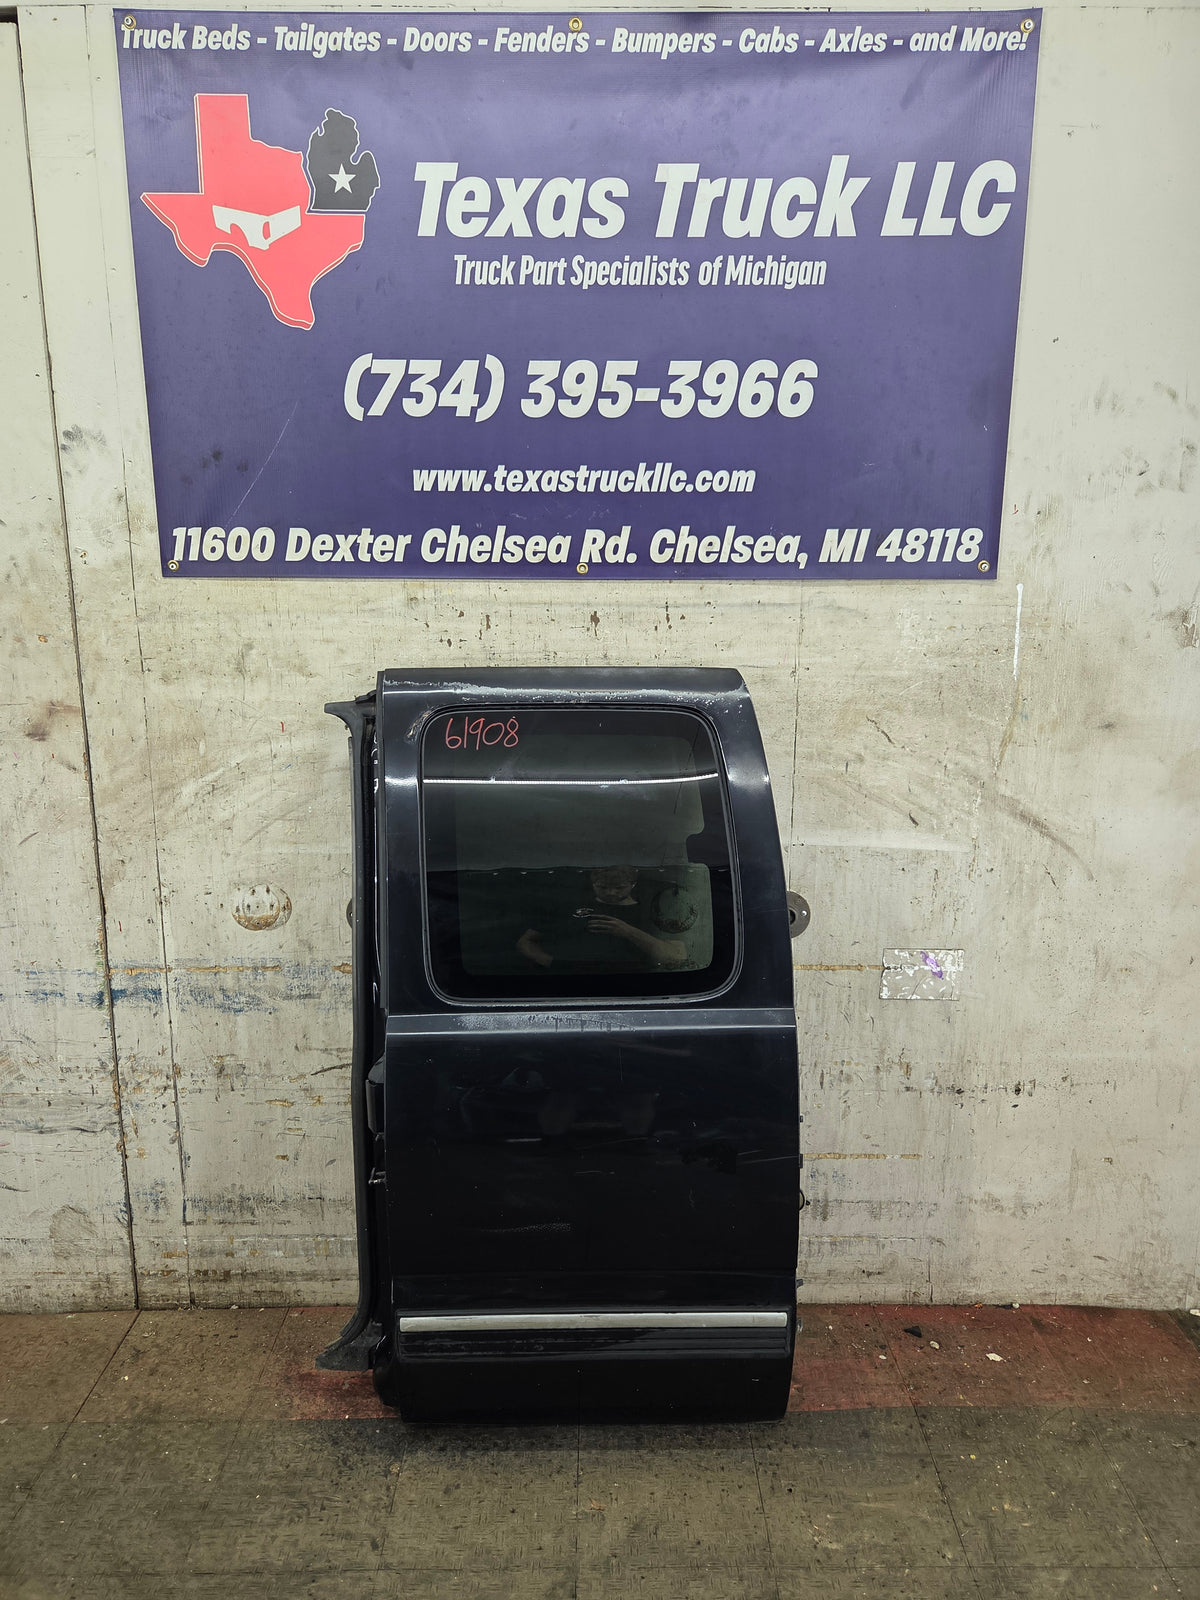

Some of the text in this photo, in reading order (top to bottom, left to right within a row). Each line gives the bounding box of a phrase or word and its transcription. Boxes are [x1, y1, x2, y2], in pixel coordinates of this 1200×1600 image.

[121, 22, 185, 50] Truck
[191, 24, 251, 51] Beds
[274, 23, 381, 58] Tailgates
[403, 26, 473, 53] Doors
[493, 24, 590, 53] Fenders
[611, 27, 716, 60] Bumpers
[738, 25, 800, 53] Cabs
[819, 26, 888, 53] Axles
[909, 25, 957, 52] and
[959, 26, 1029, 52] More!
[414, 154, 1018, 239] Texas Truck LLC
[453, 253, 828, 290] Truck Part Specialists of Michigan
[343, 352, 819, 423] (734) 395-3966
[412, 462, 757, 493] www.texastruckllc.com
[171, 524, 984, 570] 11600 Dexter Chelsea Rd. Chelsea, MI 48118
[444, 715, 520, 751] 61908
